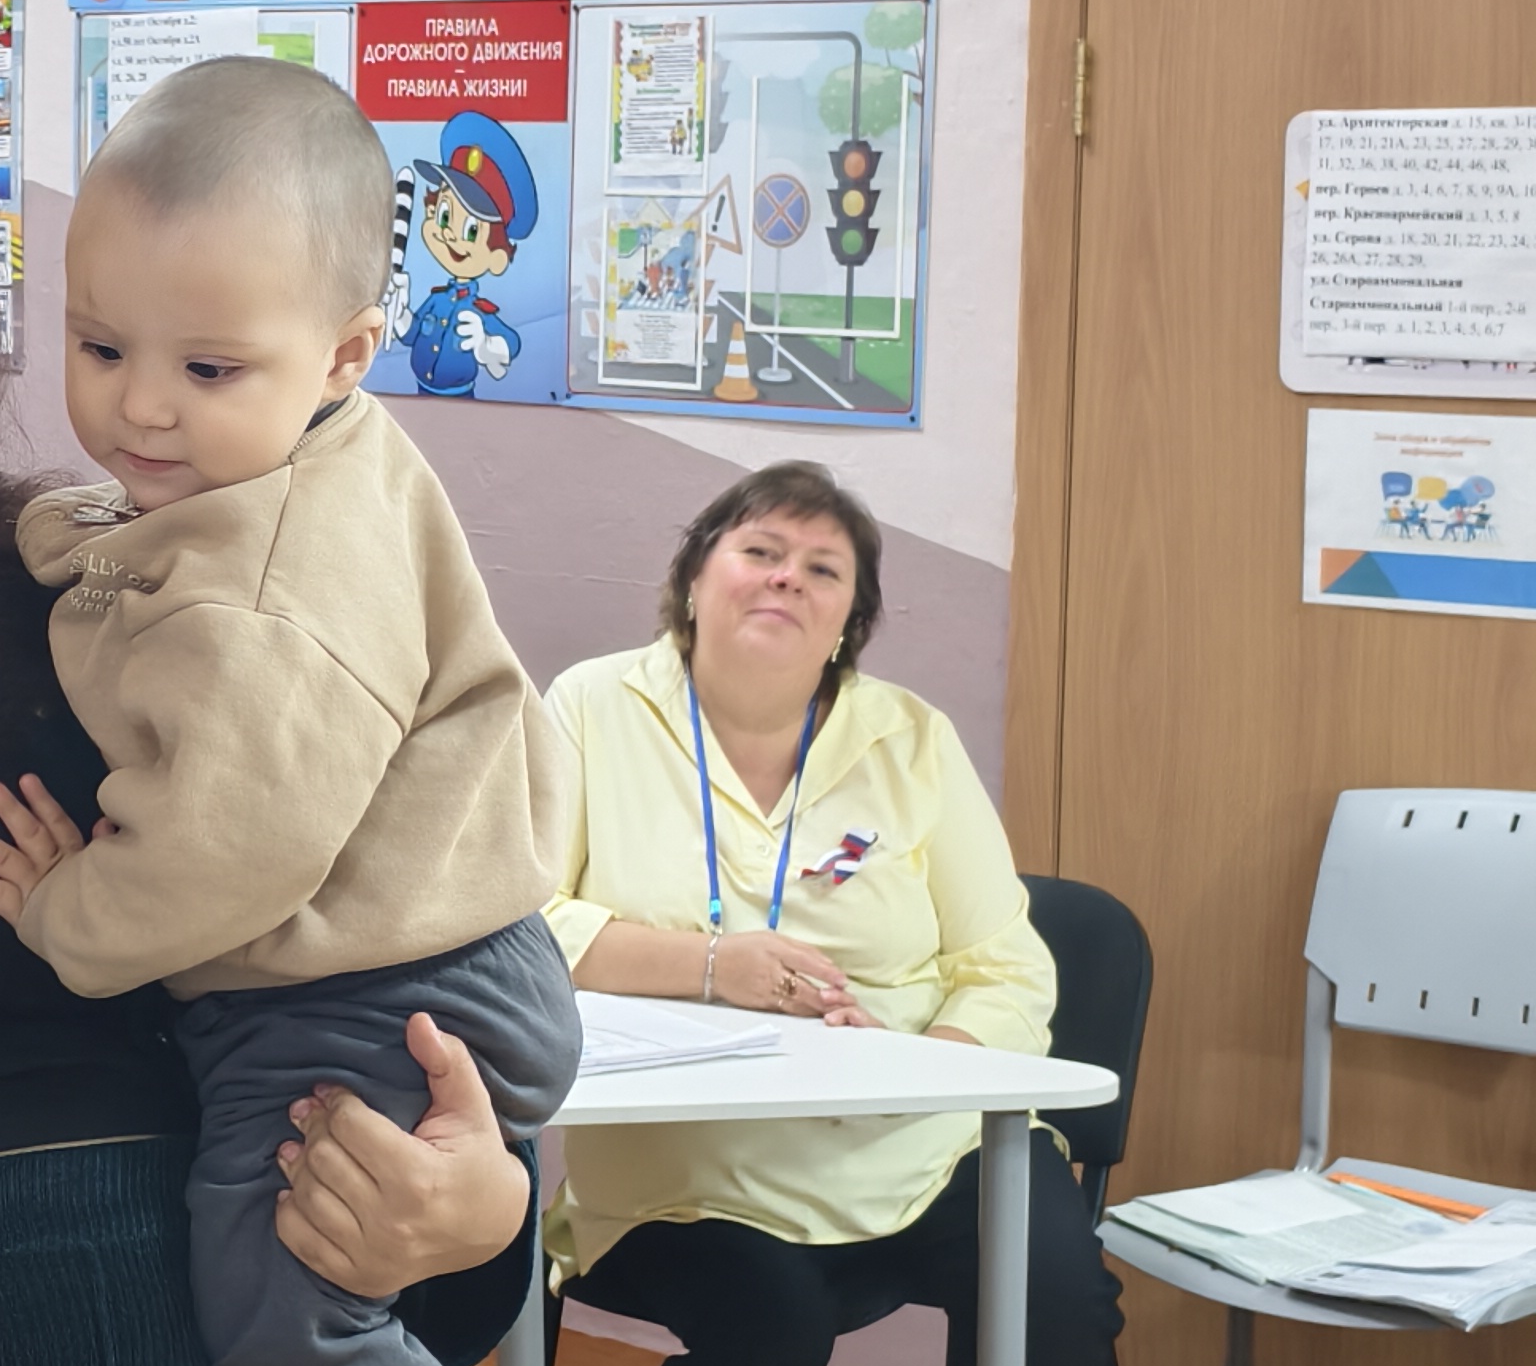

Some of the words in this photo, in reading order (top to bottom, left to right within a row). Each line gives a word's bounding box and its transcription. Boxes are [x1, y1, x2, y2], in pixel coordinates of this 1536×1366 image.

[425, 18, 499, 37] ПРАВИЛА
[363, 42, 469, 64] ДОРОЖНОГО
[472, 41, 563, 63] ДВИЖЕНИЯ
[387, 79, 460, 98] ПРАВИЛА
[463, 78, 528, 98] ЖИЗНИ!
[1318, 118, 1336, 131] ул.
[1491, 159, 1510, 172] 48,
